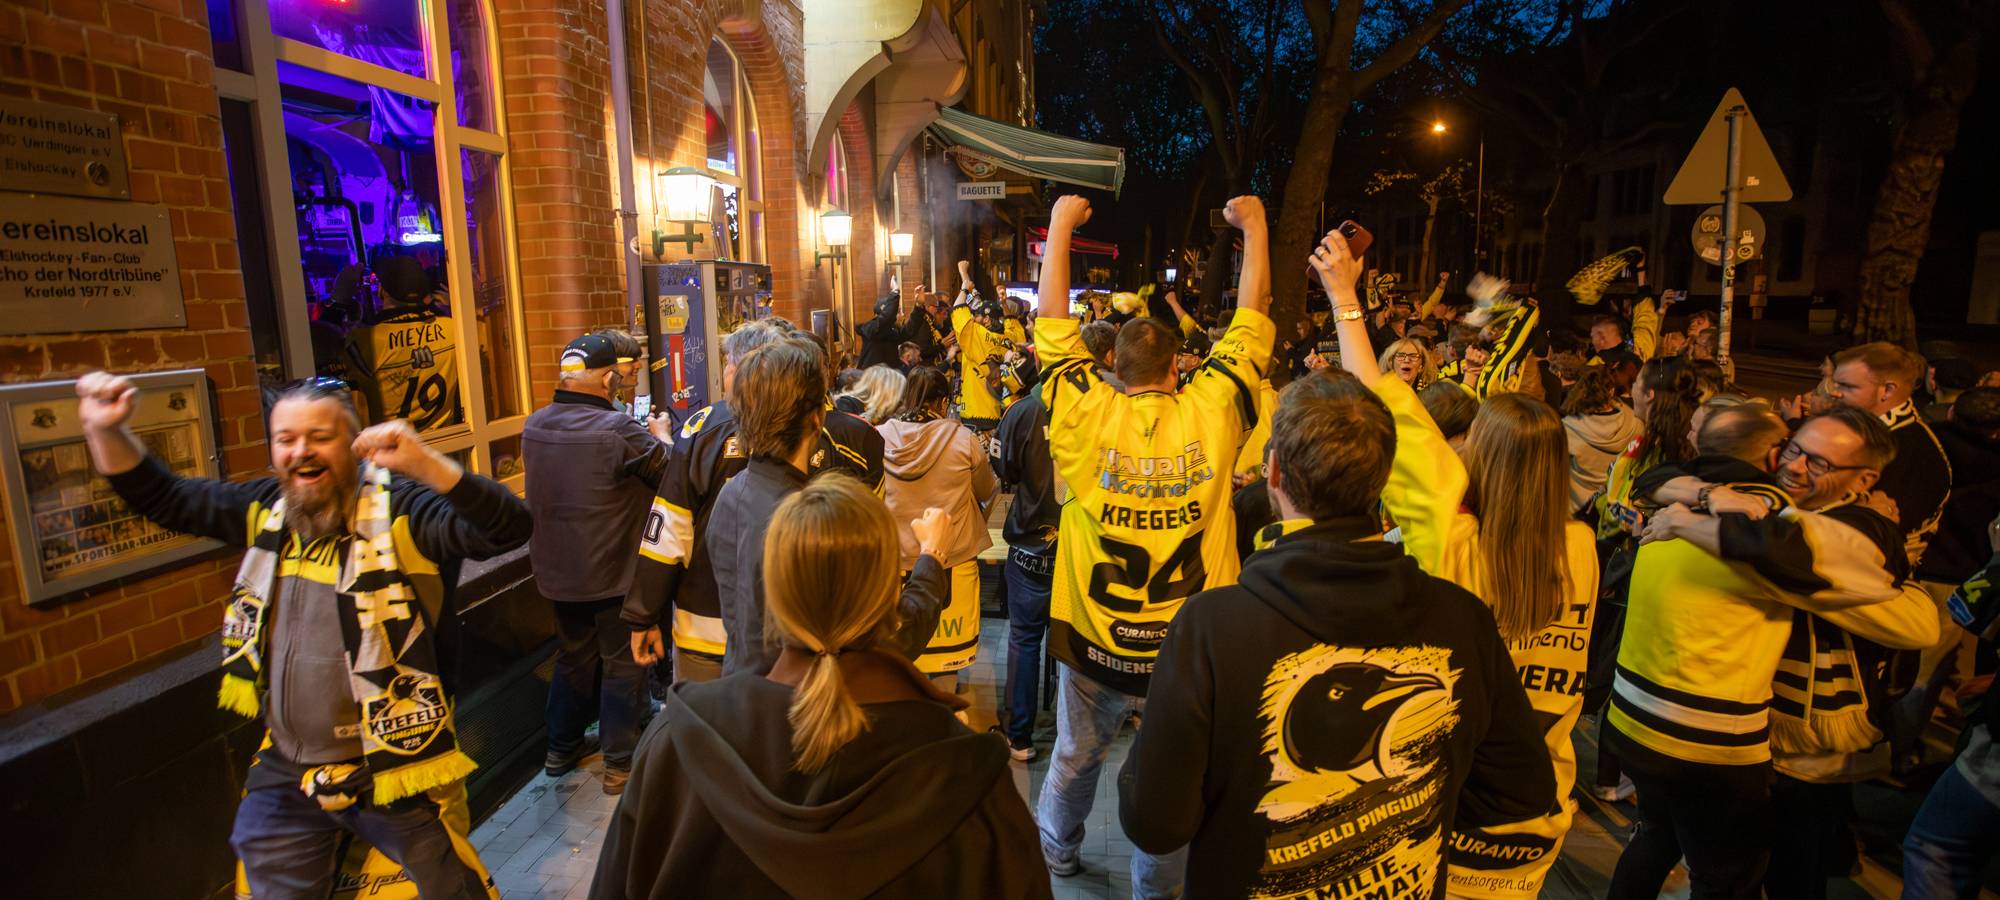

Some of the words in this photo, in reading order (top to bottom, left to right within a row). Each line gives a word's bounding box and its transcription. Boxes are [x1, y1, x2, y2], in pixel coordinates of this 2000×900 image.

[961, 185, 1001, 195] BAGUETTE
[2, 219, 149, 245] ereinslokal
[0, 266, 29, 281] cho
[35, 267, 64, 281] der
[24, 286, 76, 298] Krefeld
[79, 286, 109, 297] 1977
[112, 286, 136, 297] e.V.
[389, 323, 446, 350] MEYER
[397, 373, 448, 433] 19
[44, 530, 187, 571] www.SPORTSBAR-KARUSS
[1088, 529, 1208, 613] 24
[1087, 647, 1155, 674] SEIDENS
[368, 705, 446, 736] KREFELD
[1267, 822, 1356, 865] KREFELD
[1356, 779, 1437, 833] PINGUINE
[1296, 856, 1407, 900] MILIE.
